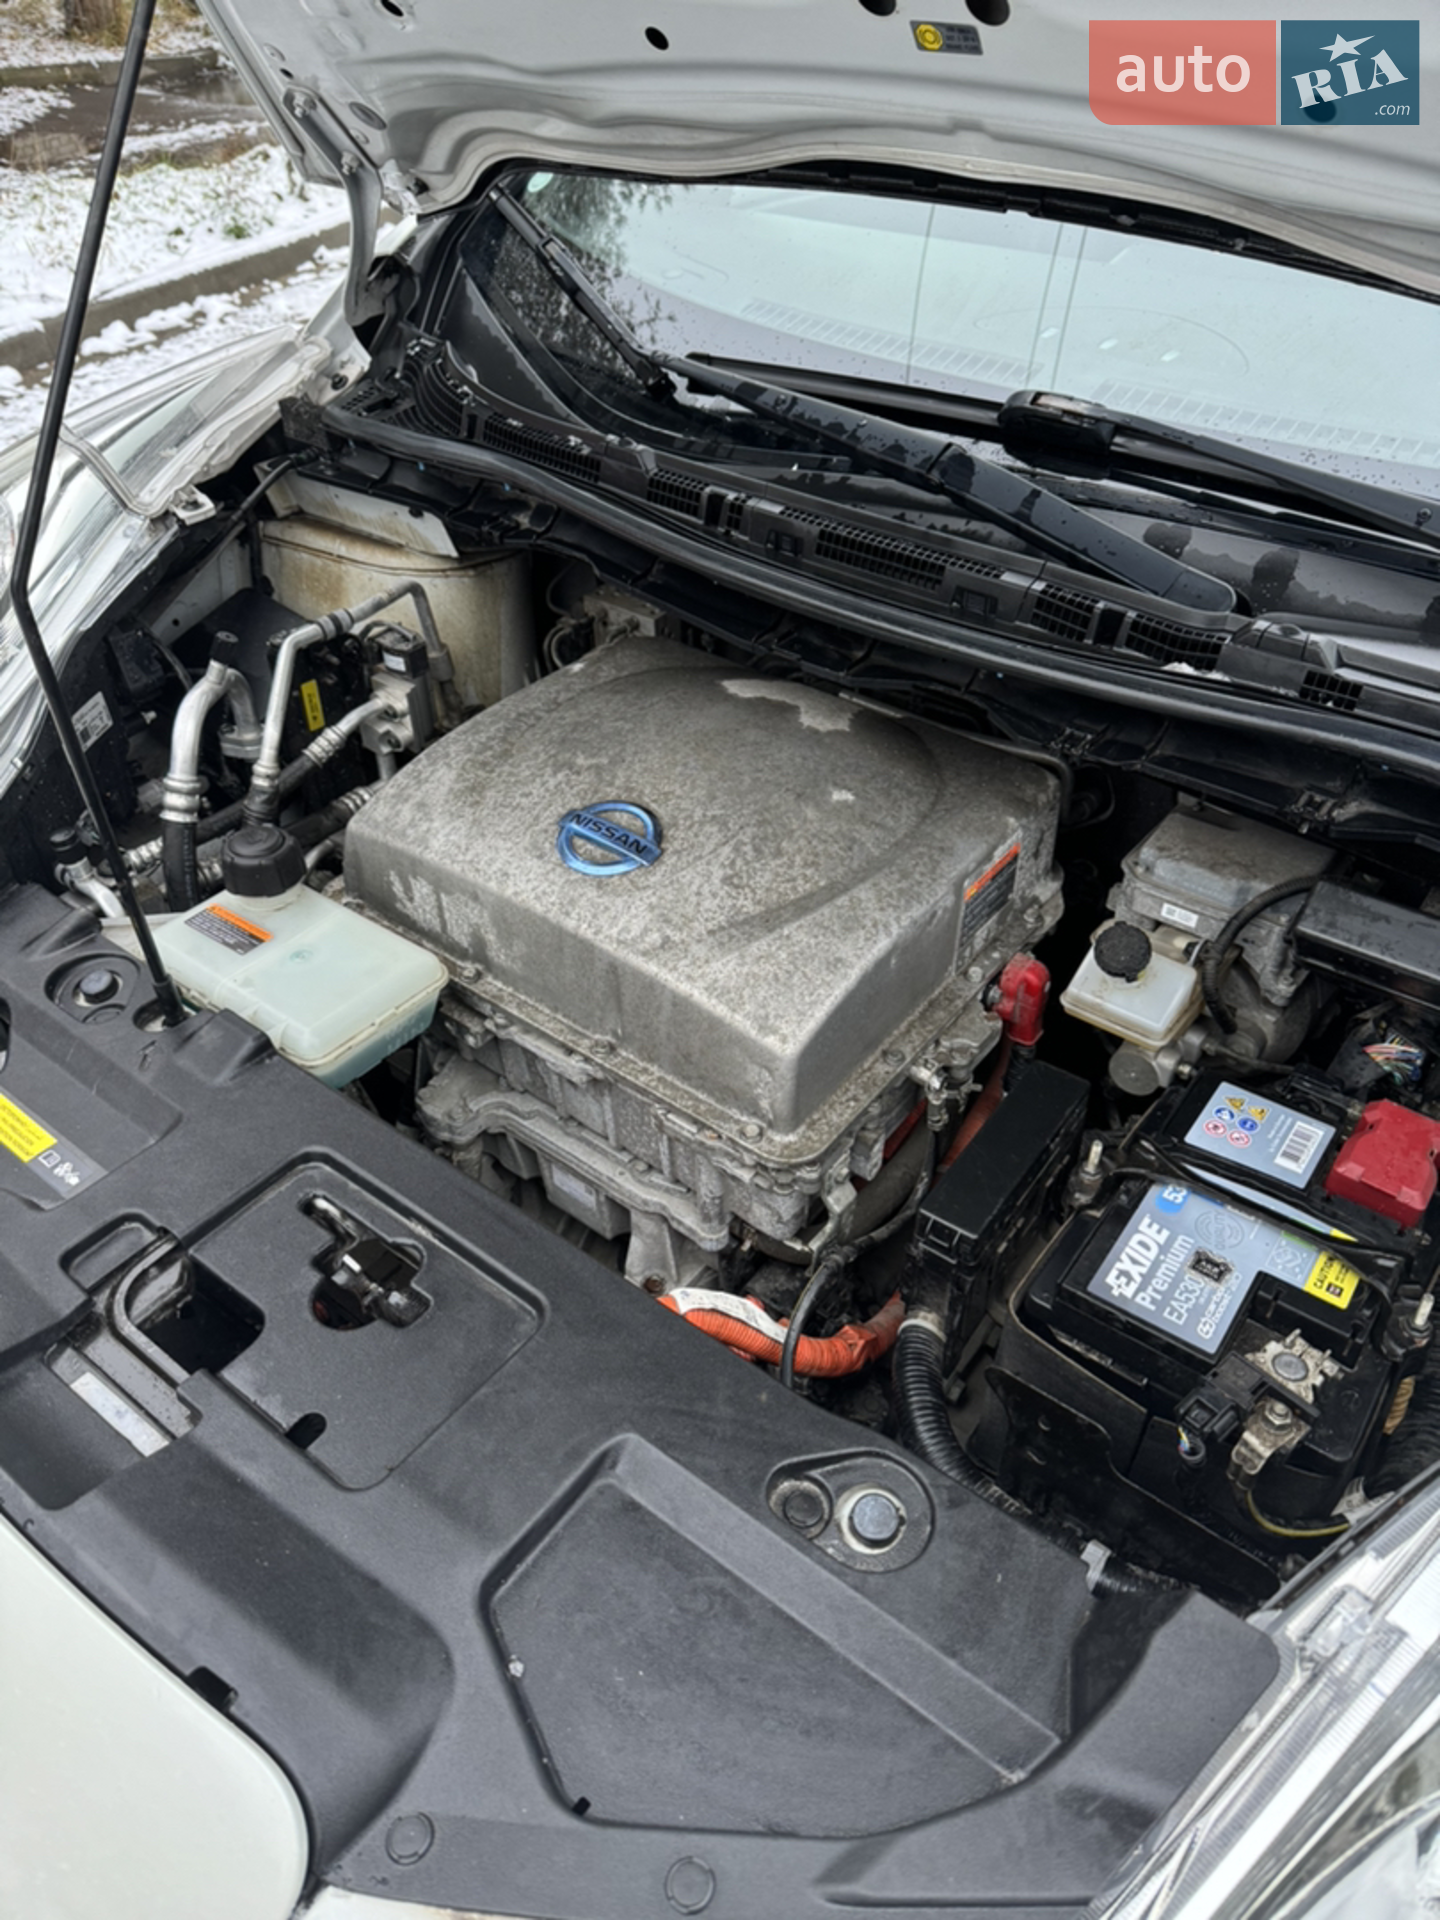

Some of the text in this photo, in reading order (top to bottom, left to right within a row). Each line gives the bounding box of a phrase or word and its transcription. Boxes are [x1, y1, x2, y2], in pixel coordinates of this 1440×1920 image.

[569, 813, 648, 854] NISSAN
[1105, 1215, 1171, 1299] EXIDE
[1134, 1234, 1195, 1311] Premium
[1162, 1273, 1206, 1326] EA530
[1205, 1286, 1225, 1317] carbo
